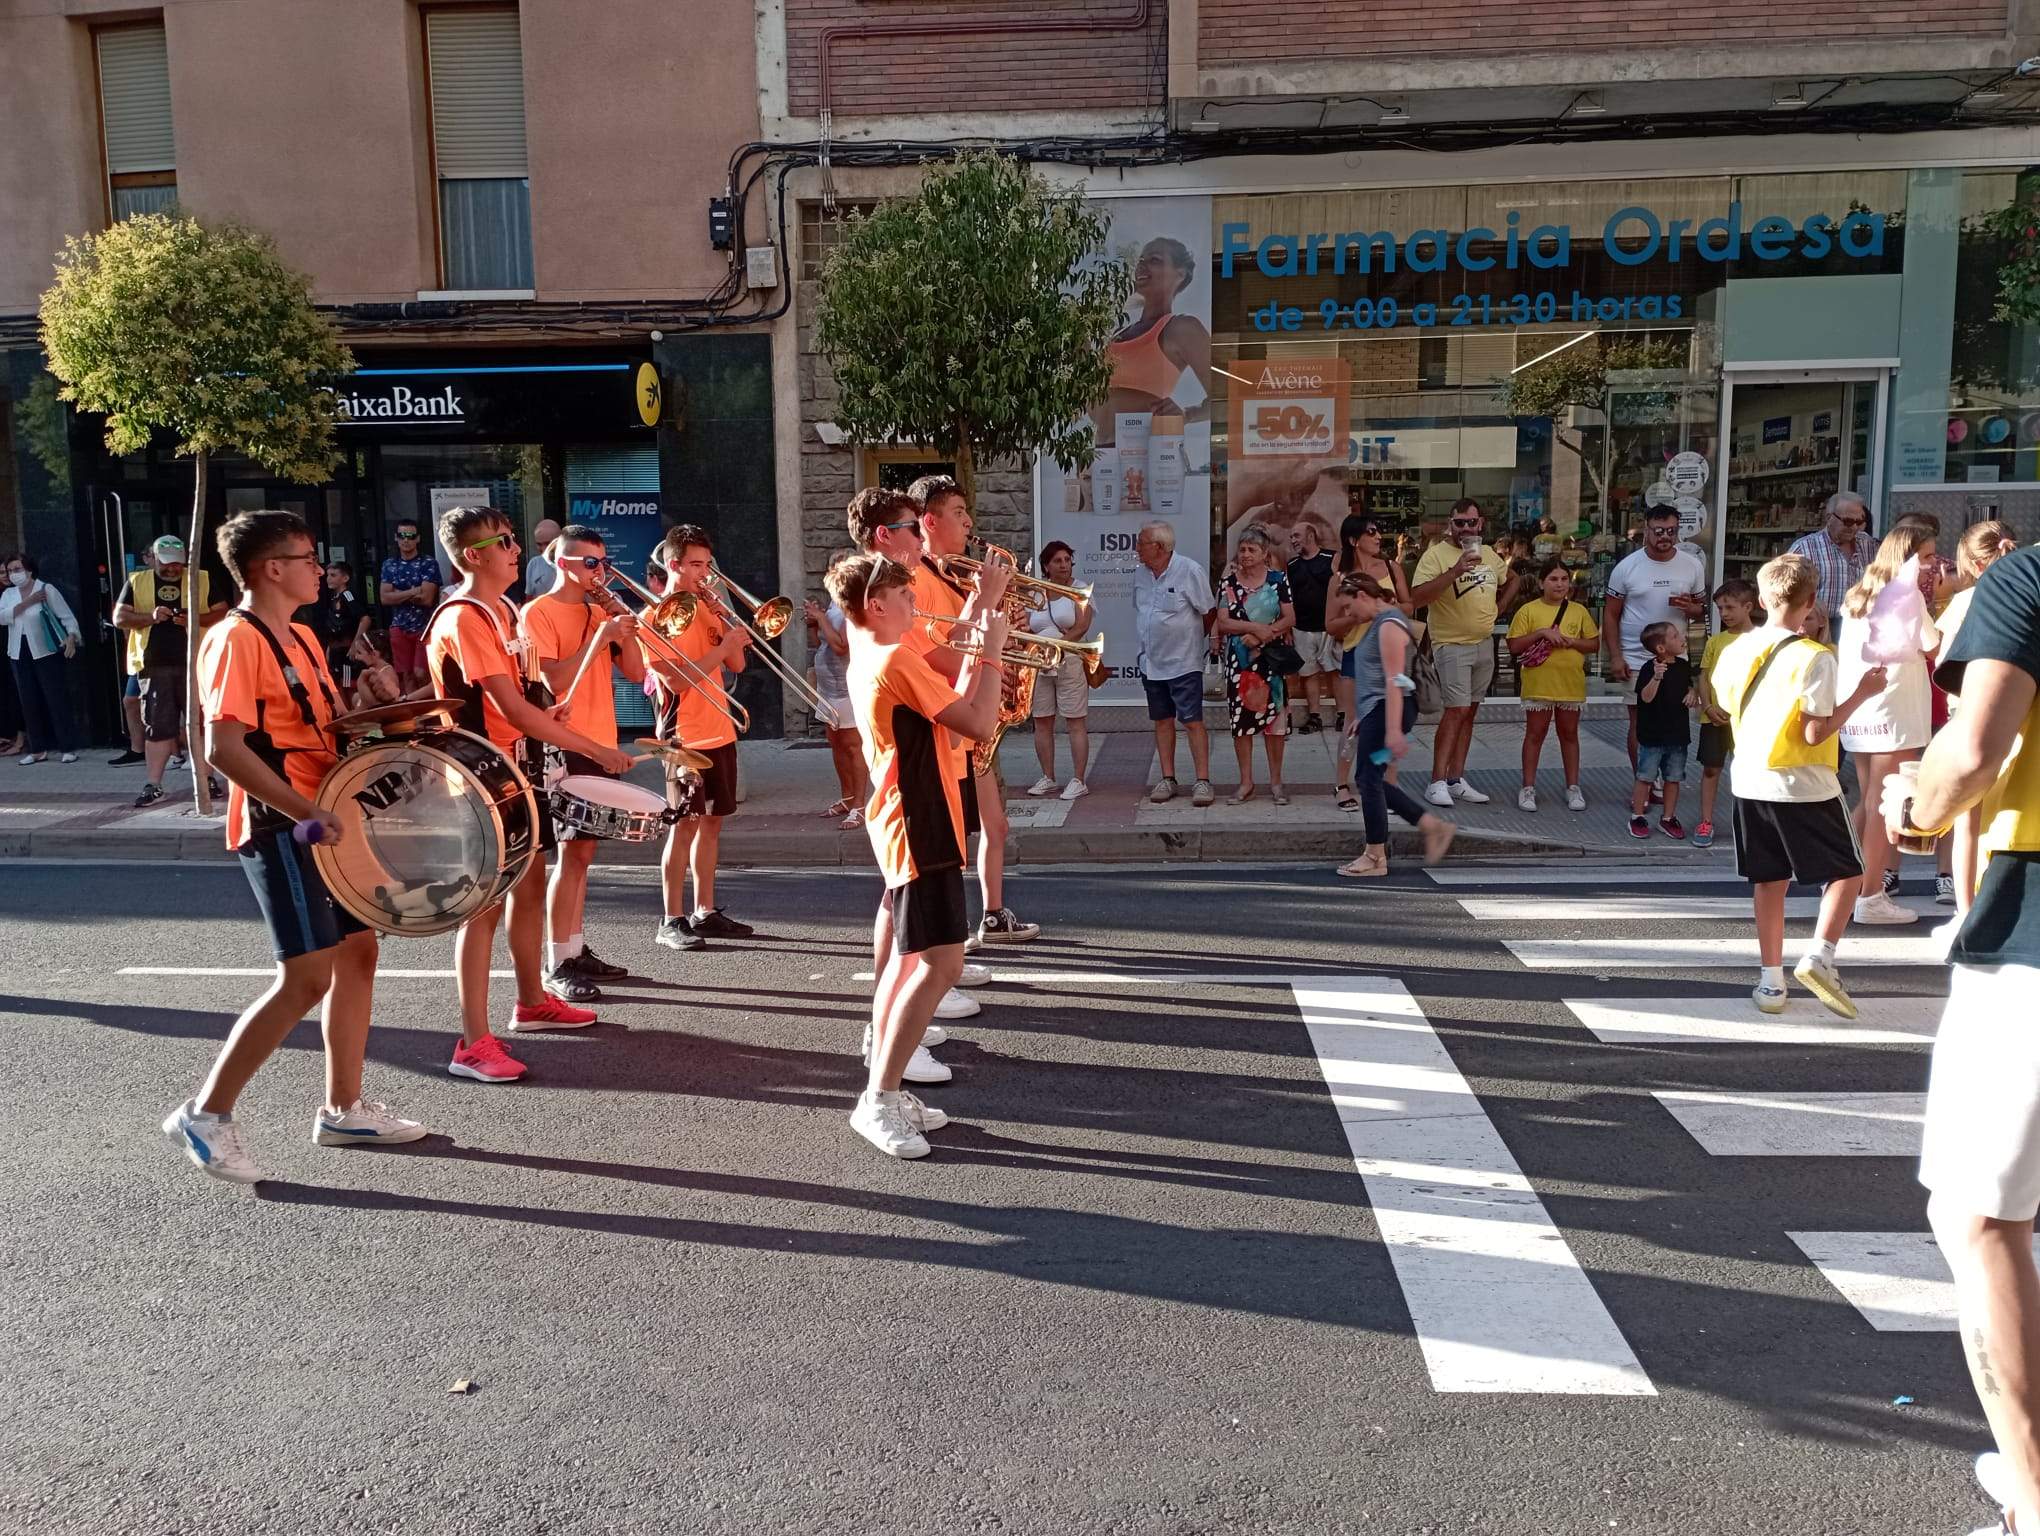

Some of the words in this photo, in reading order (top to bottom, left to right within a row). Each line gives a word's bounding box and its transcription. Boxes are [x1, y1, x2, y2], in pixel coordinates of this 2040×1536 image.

[1221, 211, 1571, 279] Farmacia
[1603, 202, 1886, 266] Ordesa
[1254, 300, 1304, 332] de
[1320, 298, 1398, 330] 9:00
[1412, 302, 1436, 327] a
[1450, 292, 1557, 326] 21:30
[1572, 291, 1683, 322] horas
[1256, 366, 1322, 390] Avène
[1248, 406, 1330, 440] -50%
[572, 499, 658, 520] MyHome
[1100, 533, 1137, 552] ISDI
[1085, 553, 1139, 562] FOTOPROT
[1122, 666, 1142, 679] ISD
